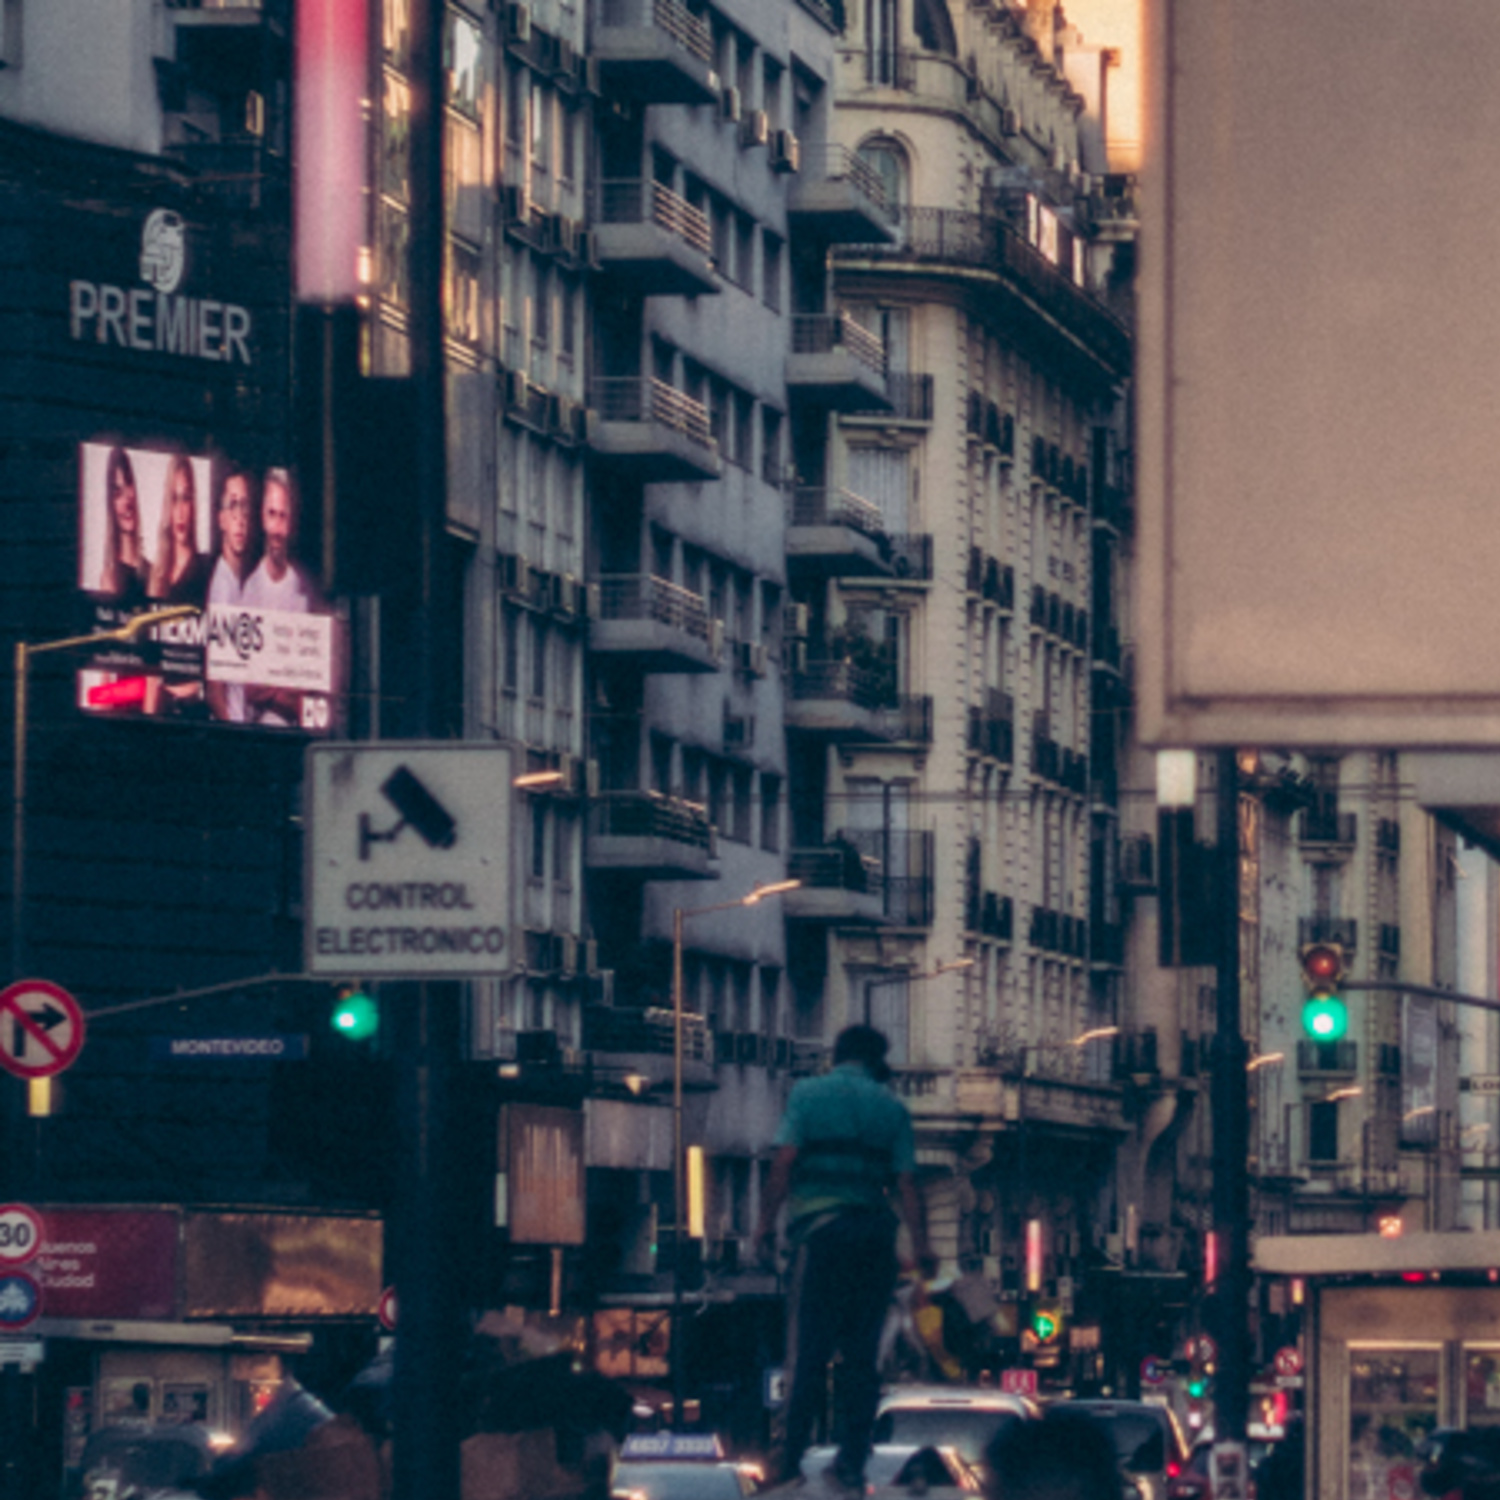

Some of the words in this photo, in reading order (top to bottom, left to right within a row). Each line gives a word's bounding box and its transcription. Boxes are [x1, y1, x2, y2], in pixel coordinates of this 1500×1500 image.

[70, 280, 251, 365] PREMIER
[345, 881, 475, 910] CONTROL
[316, 926, 505, 954] ELECTRONICO
[171, 1039, 284, 1055] MONTEVIDEO
[0, 1222, 31, 1248] 30
